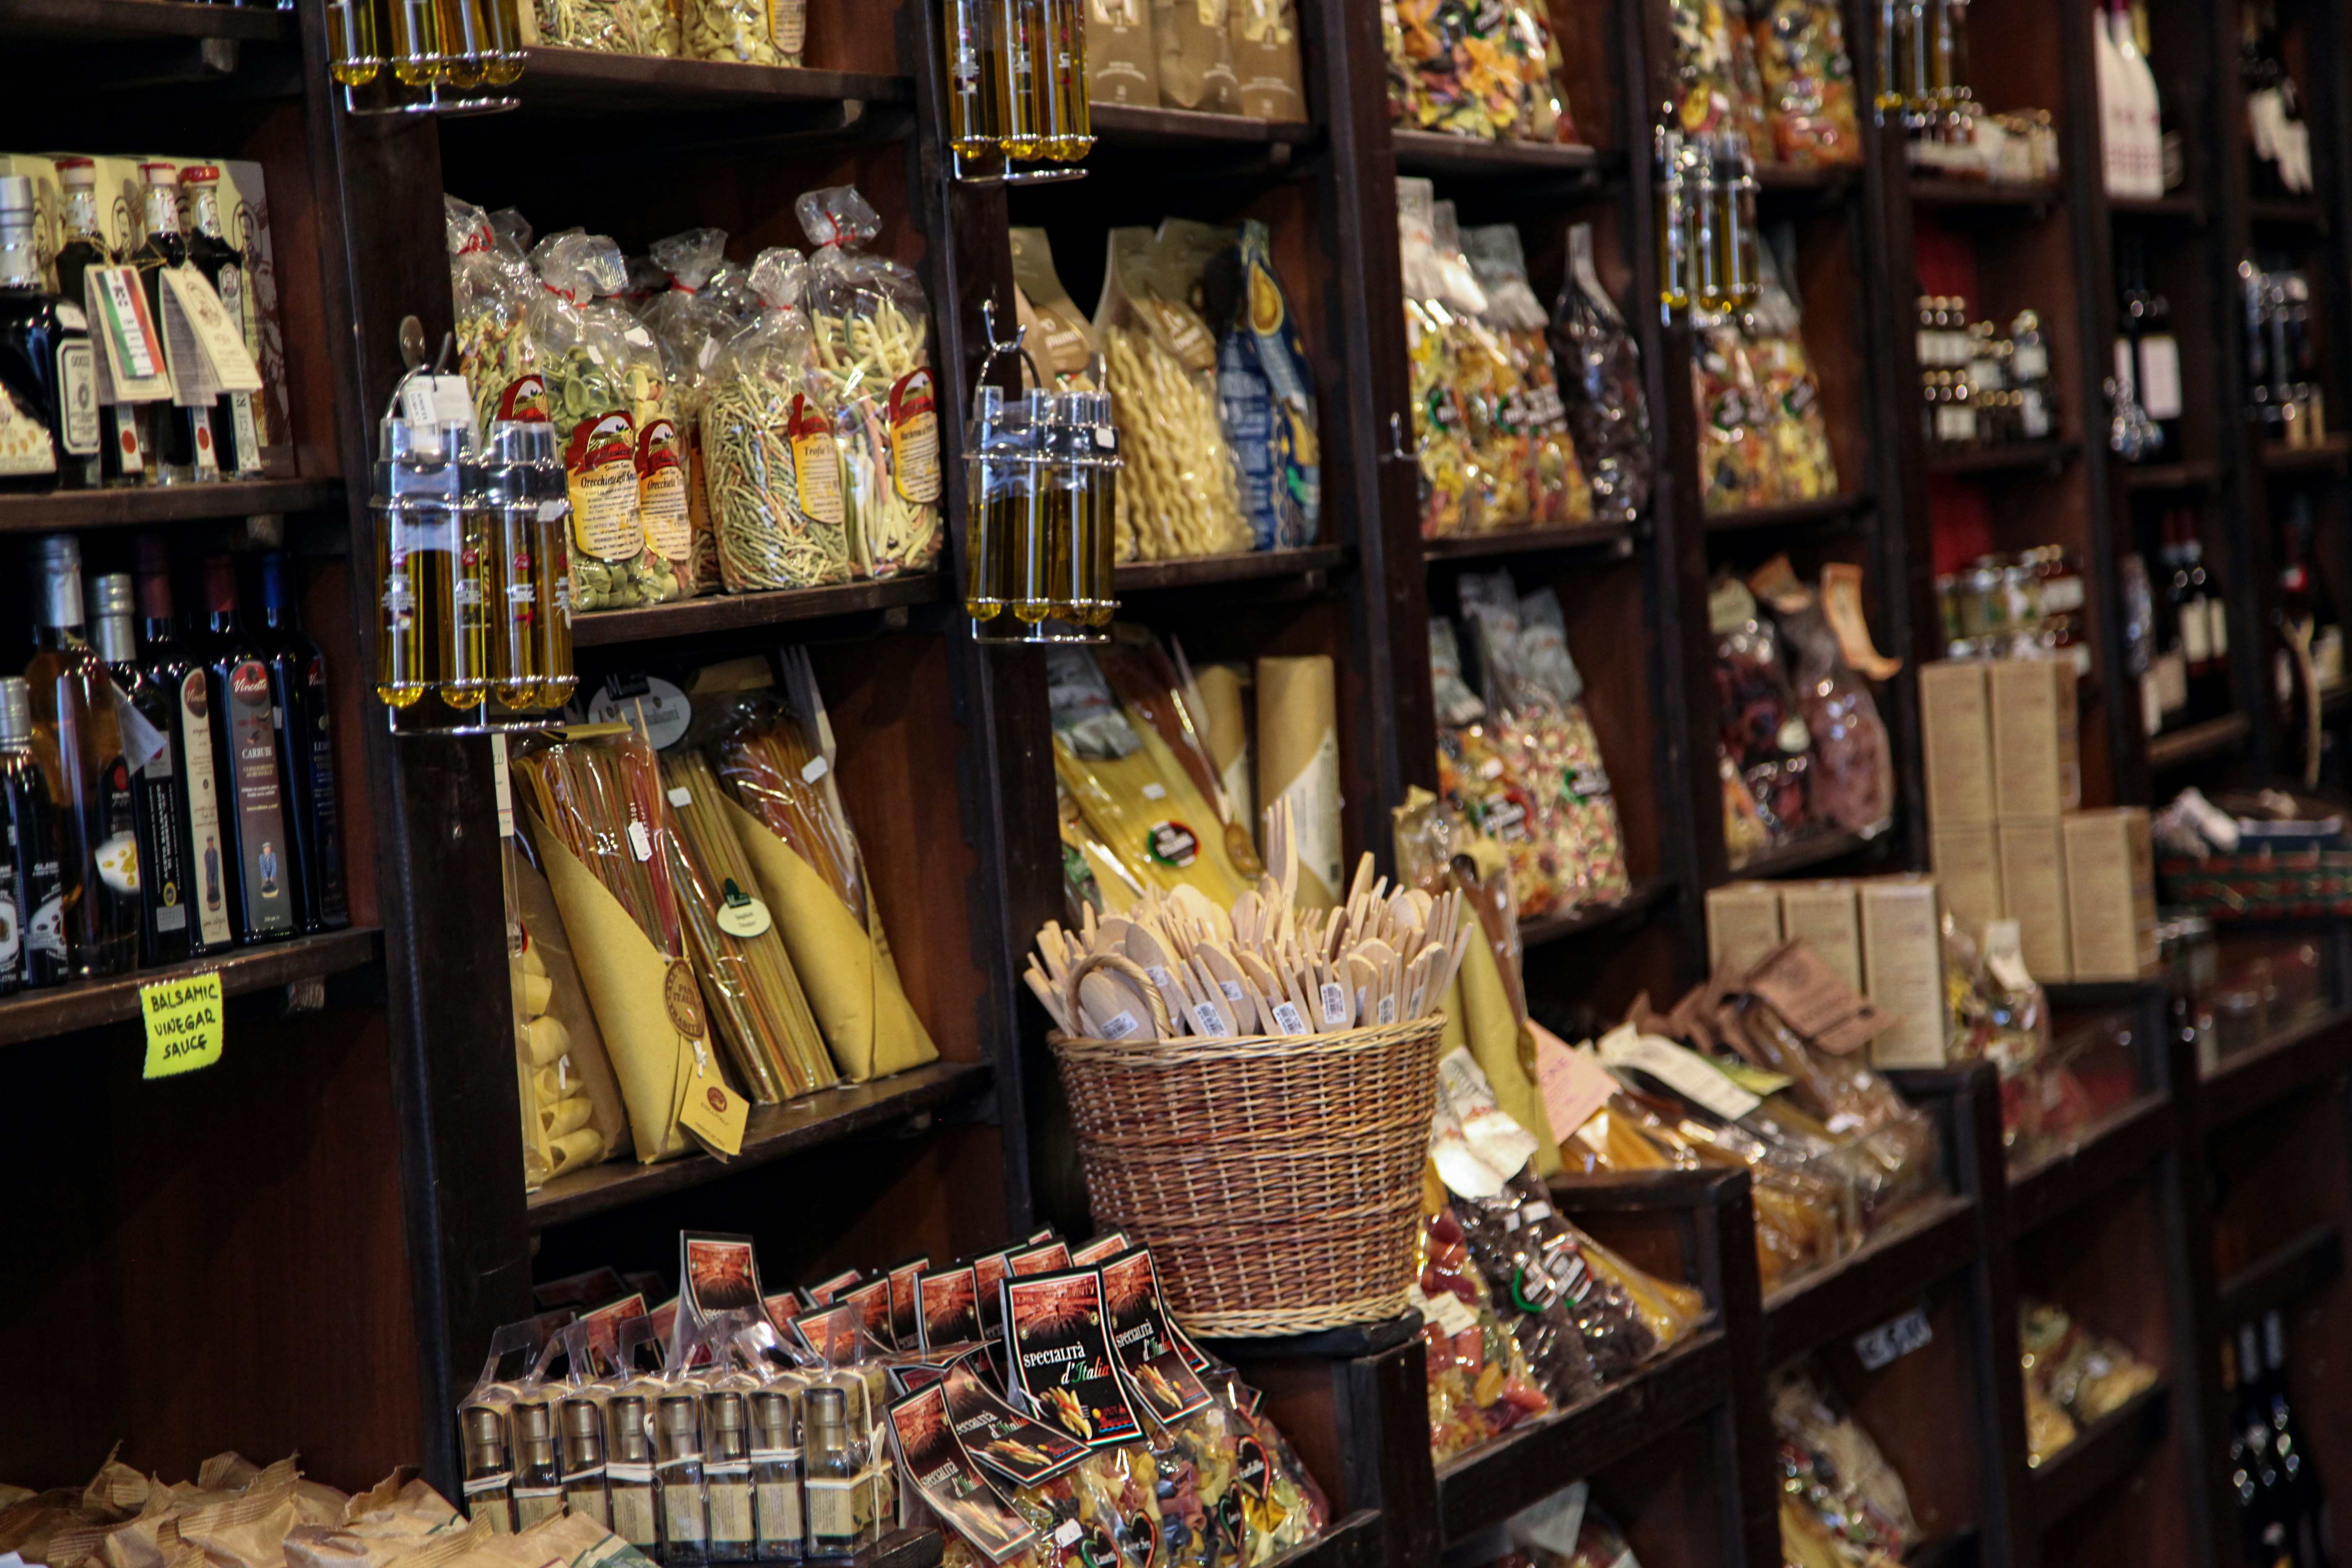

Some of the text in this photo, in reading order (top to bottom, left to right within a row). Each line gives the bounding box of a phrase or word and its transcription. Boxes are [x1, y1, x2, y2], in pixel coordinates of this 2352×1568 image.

[151, 983, 218, 1013] BALSAMIC
[154, 1008, 216, 1037] VINEGAR
[162, 1033, 207, 1060] SAUCE
[1060, 1355, 1110, 1385] d'Italia
